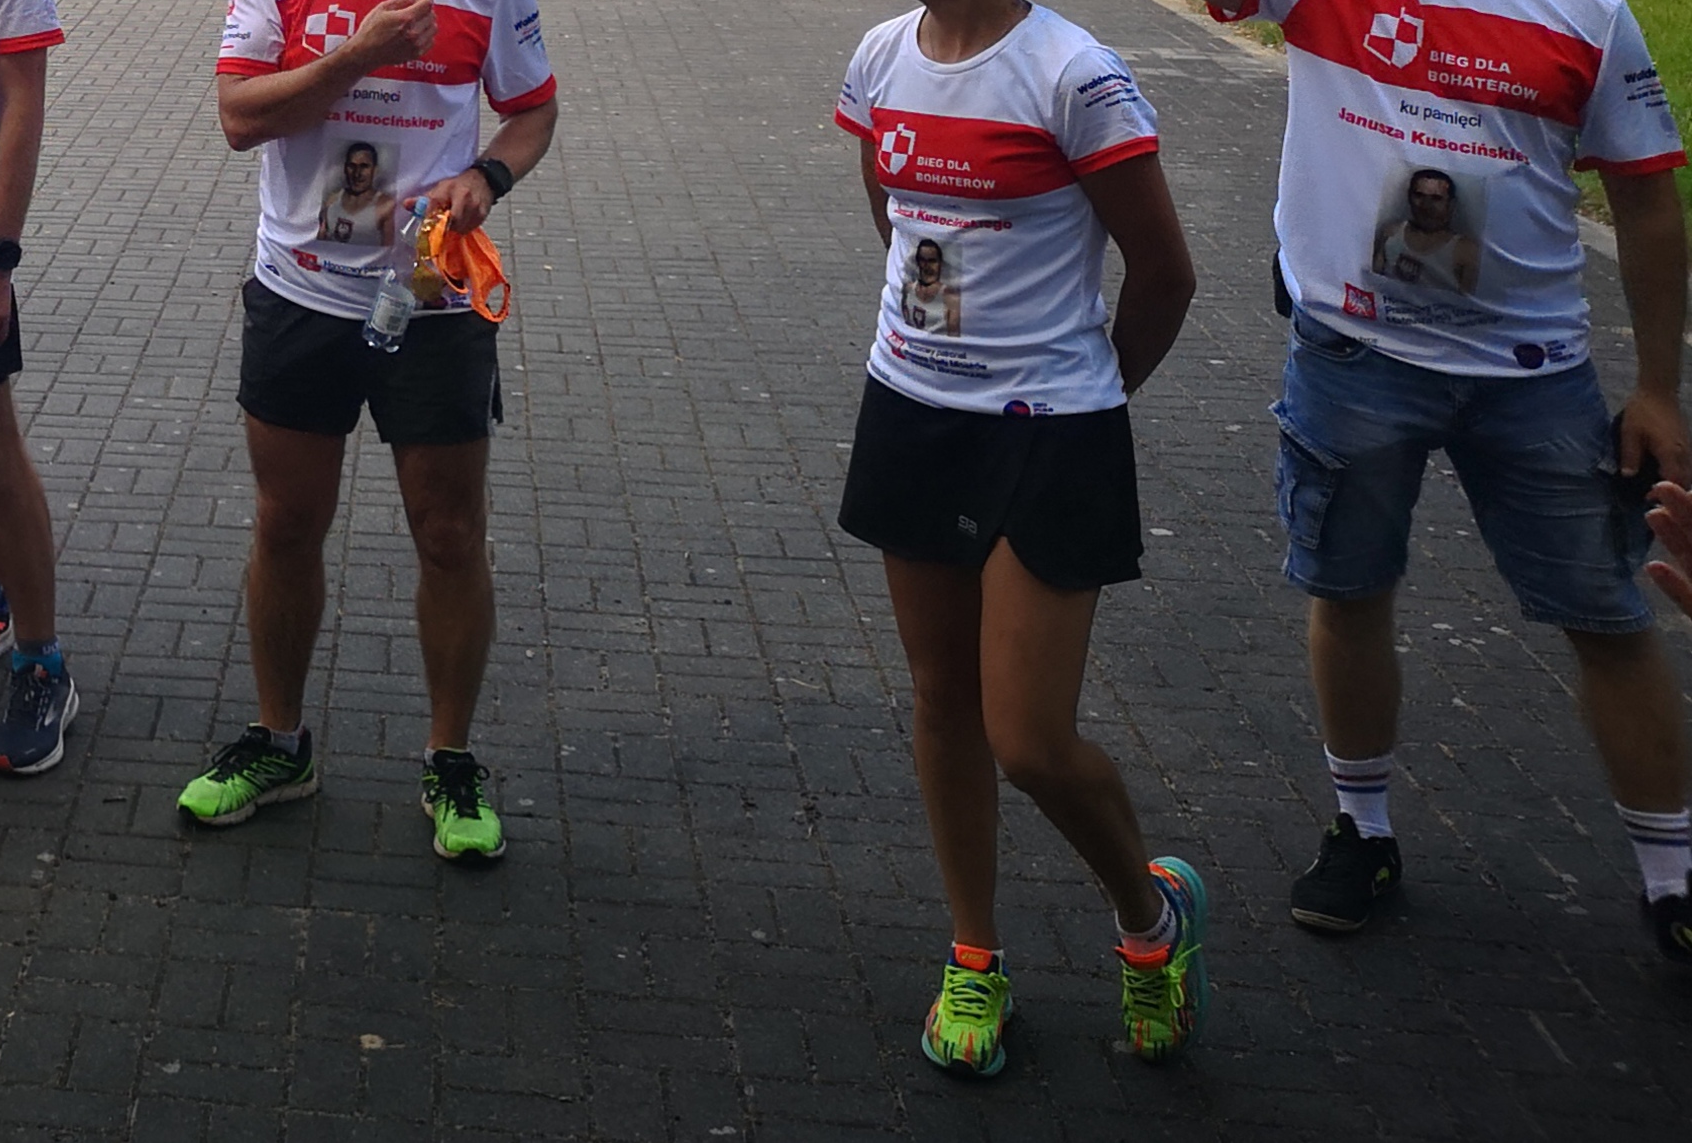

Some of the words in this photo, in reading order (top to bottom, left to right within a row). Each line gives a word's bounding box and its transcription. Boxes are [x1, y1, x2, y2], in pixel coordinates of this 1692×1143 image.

[1430, 50, 1469, 68] BIEG
[1475, 57, 1511, 74] DLA
[353, 88, 402, 103] pamięci
[1428, 70, 1539, 101] BOHATERÓW
[345, 110, 446, 130] Kusocińskiego
[1338, 107, 1405, 141] Janusza
[1400, 100, 1419, 115] ku
[1423, 107, 1482, 128] pamięci
[917, 156, 944, 168] BIEG
[947, 160, 971, 171] DLA
[916, 172, 996, 190] BOHATERÓW
